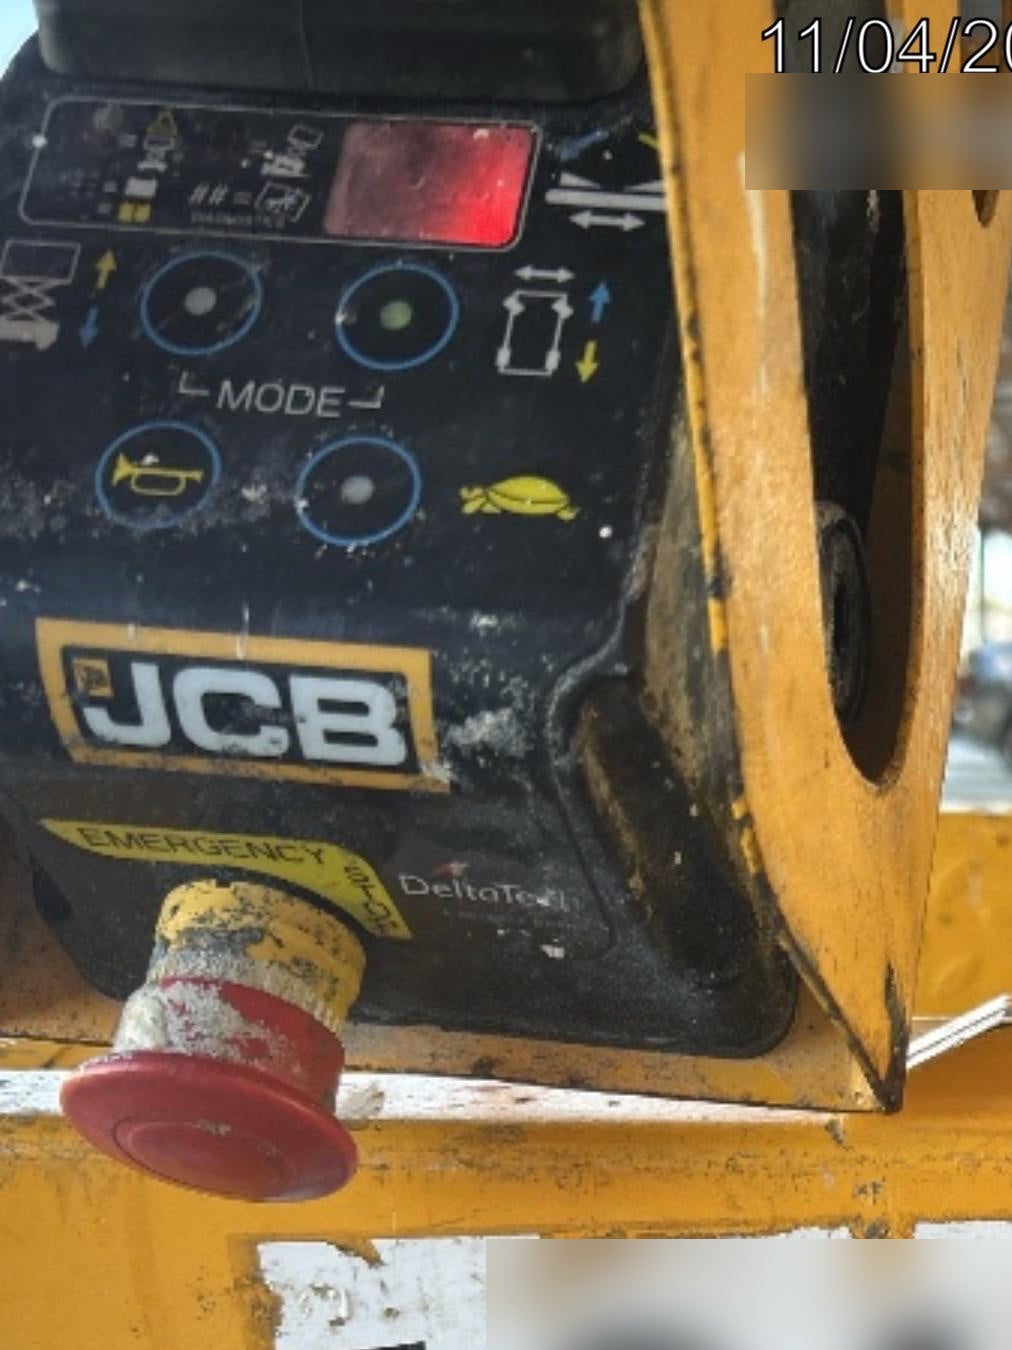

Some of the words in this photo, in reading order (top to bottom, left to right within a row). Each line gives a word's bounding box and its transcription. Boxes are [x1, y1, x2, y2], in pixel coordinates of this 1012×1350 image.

[217, 379, 346, 418] MODE
[82, 661, 409, 767] JCB
[77, 827, 326, 866] EMERGENCY
